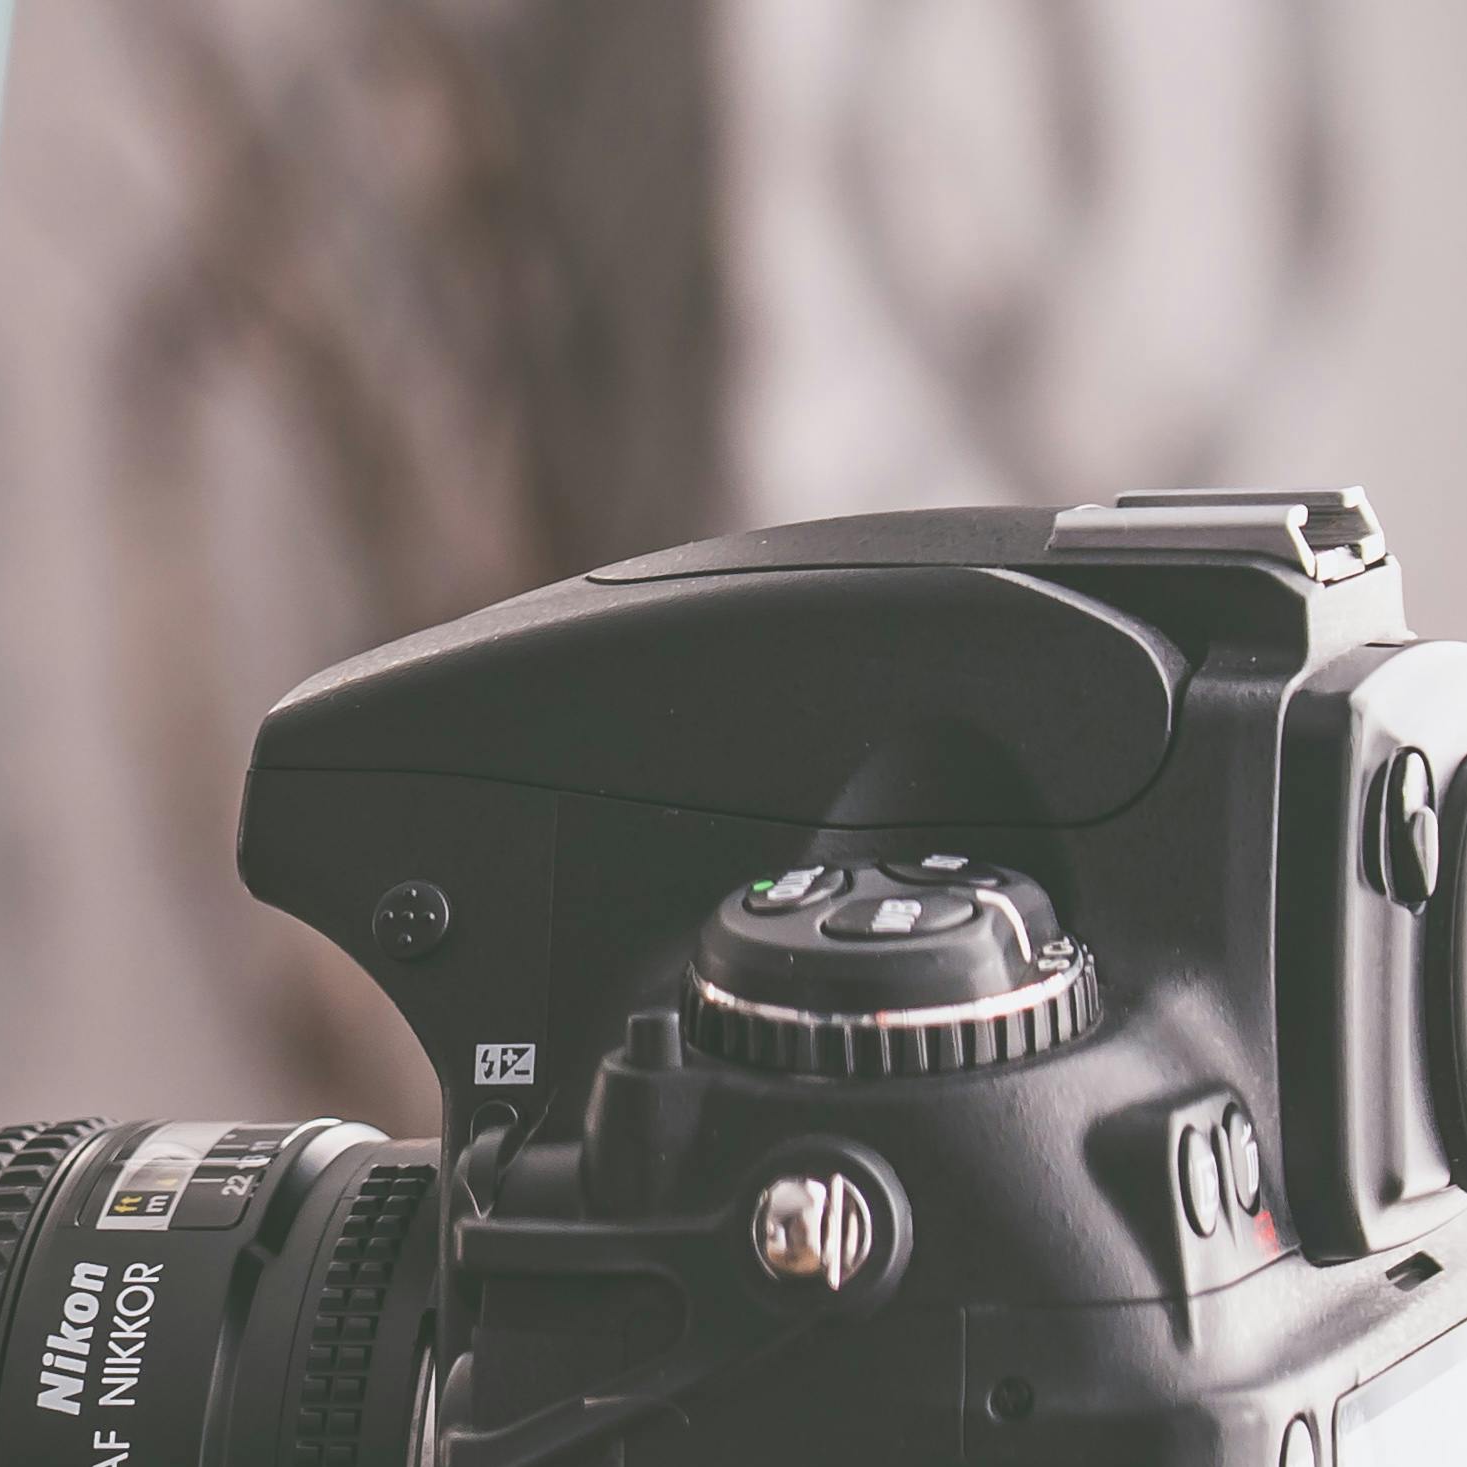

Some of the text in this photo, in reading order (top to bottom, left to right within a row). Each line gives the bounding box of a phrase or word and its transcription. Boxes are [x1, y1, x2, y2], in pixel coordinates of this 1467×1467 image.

[221, 1174, 255, 1196] 22
[36, 1261, 109, 1416] Nikon
[98, 1262, 164, 1406] NIKKOR
